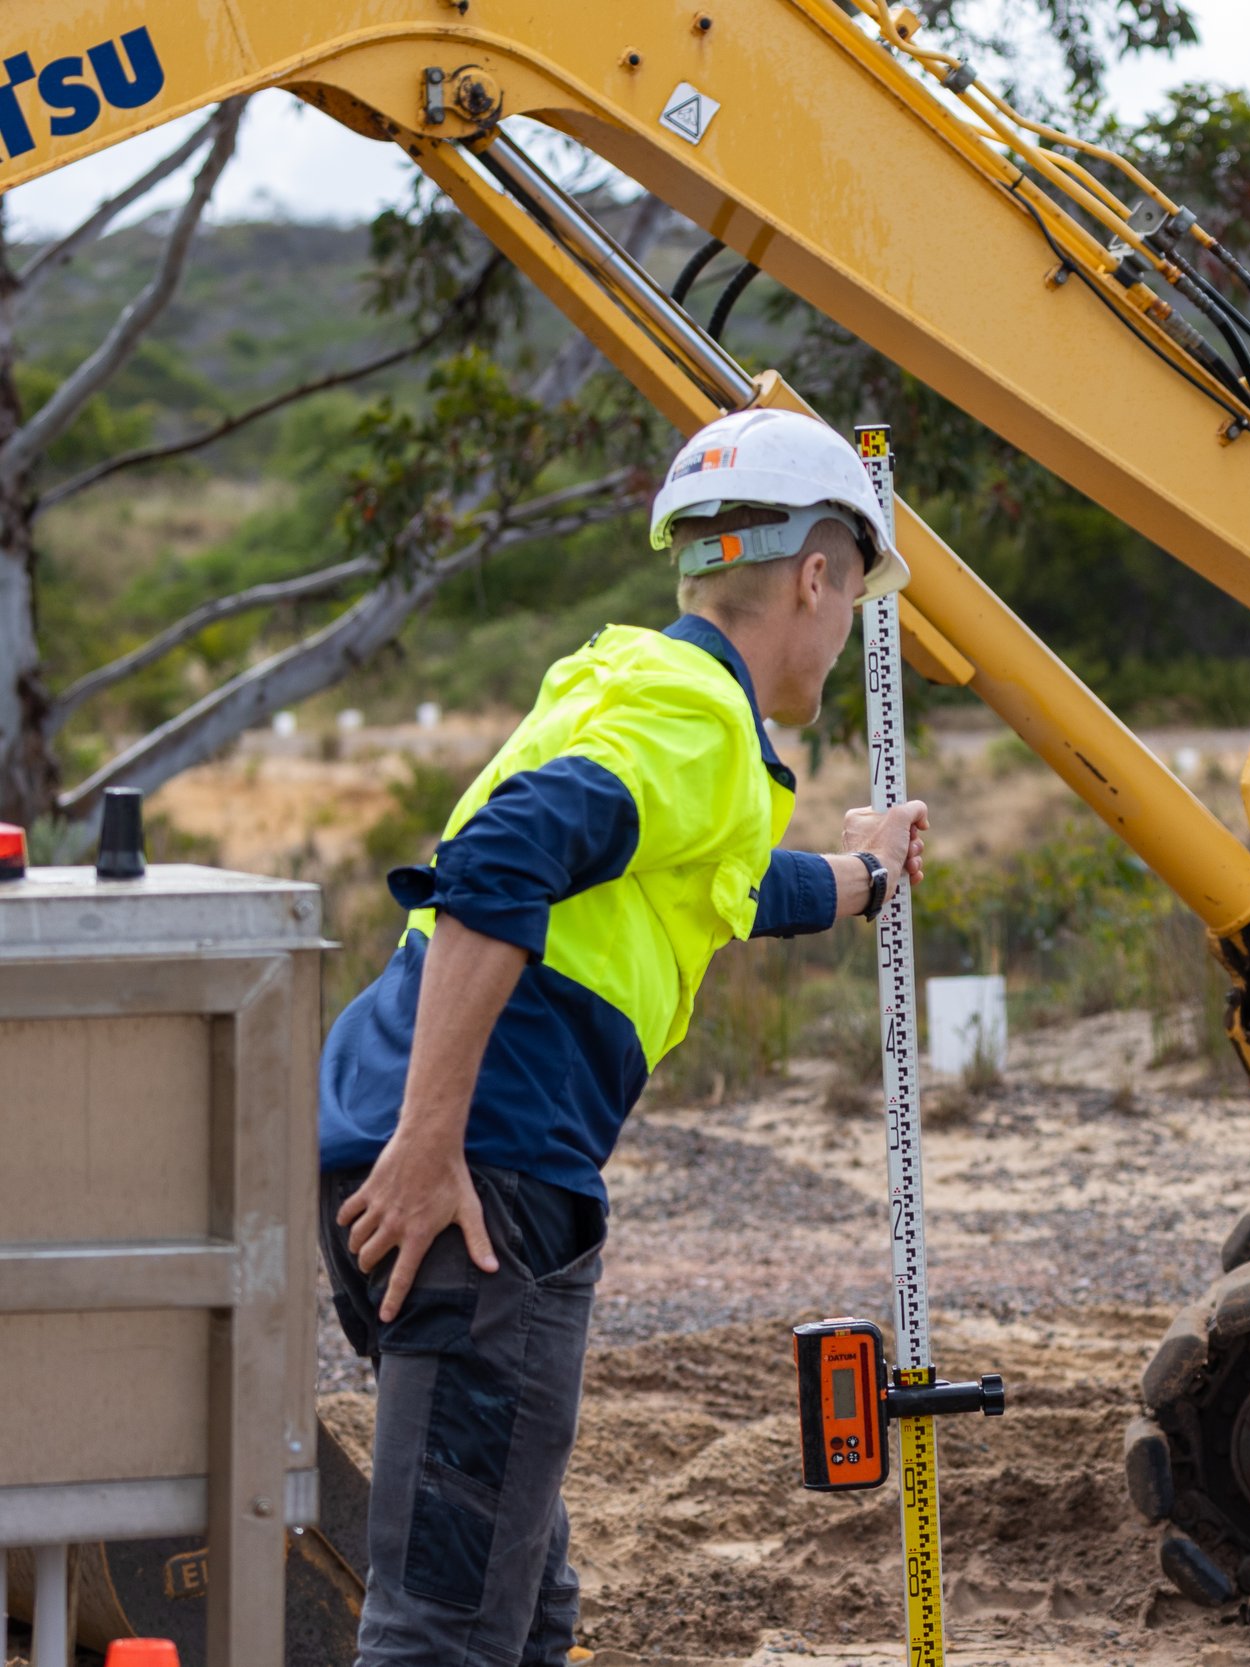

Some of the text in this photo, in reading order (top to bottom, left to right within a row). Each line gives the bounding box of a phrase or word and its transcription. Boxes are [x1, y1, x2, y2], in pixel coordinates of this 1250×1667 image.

[0, 25, 165, 164] TSU
[868, 651, 880, 693] 8
[872, 743, 882, 785] 7
[880, 926, 892, 968] 5
[885, 1017, 896, 1059] 4
[888, 1109, 900, 1151] 3
[892, 1199, 904, 1241] 2
[898, 1289, 906, 1331] 1
[828, 1353, 857, 1362] DATUM
[904, 1467, 916, 1508] 9
[908, 1556, 920, 1598] 8
